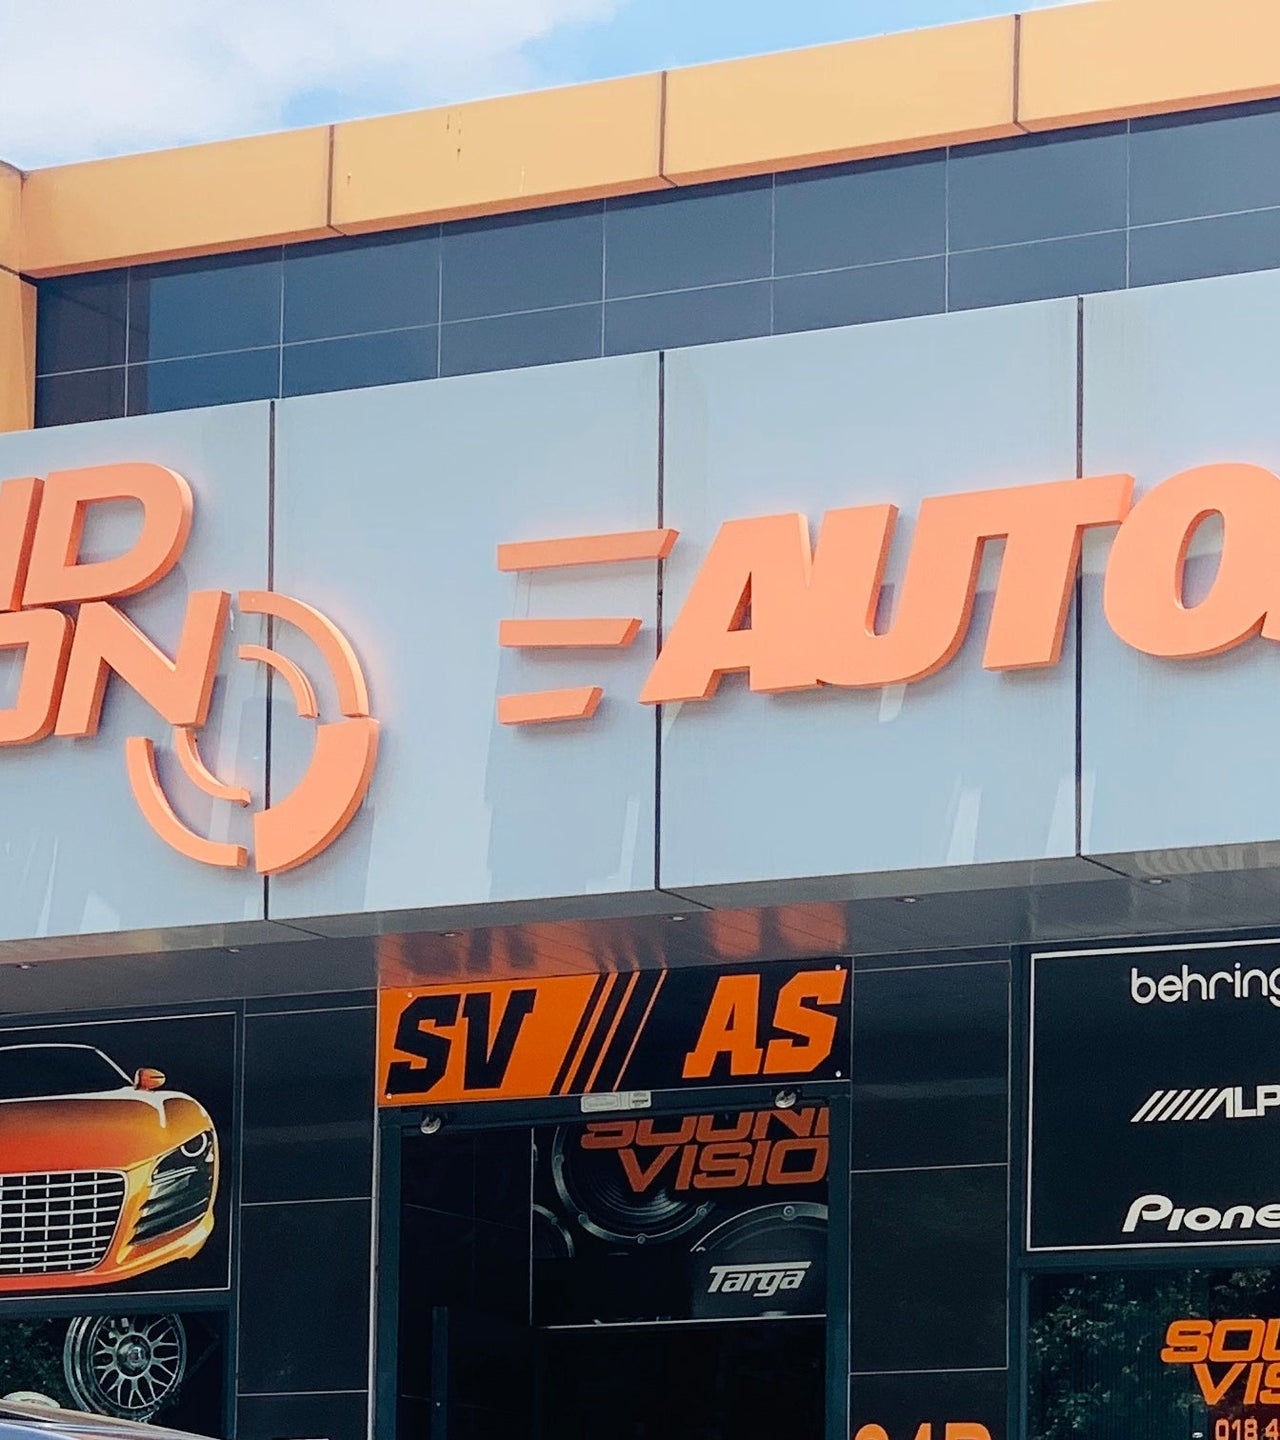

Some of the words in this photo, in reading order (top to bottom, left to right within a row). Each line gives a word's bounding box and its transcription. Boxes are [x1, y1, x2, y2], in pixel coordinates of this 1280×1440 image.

[385, 988, 536, 1097] SV
[682, 969, 847, 1079] AS
[581, 1107, 829, 1149] SOUN
[707, 1261, 812, 1297] Targa
